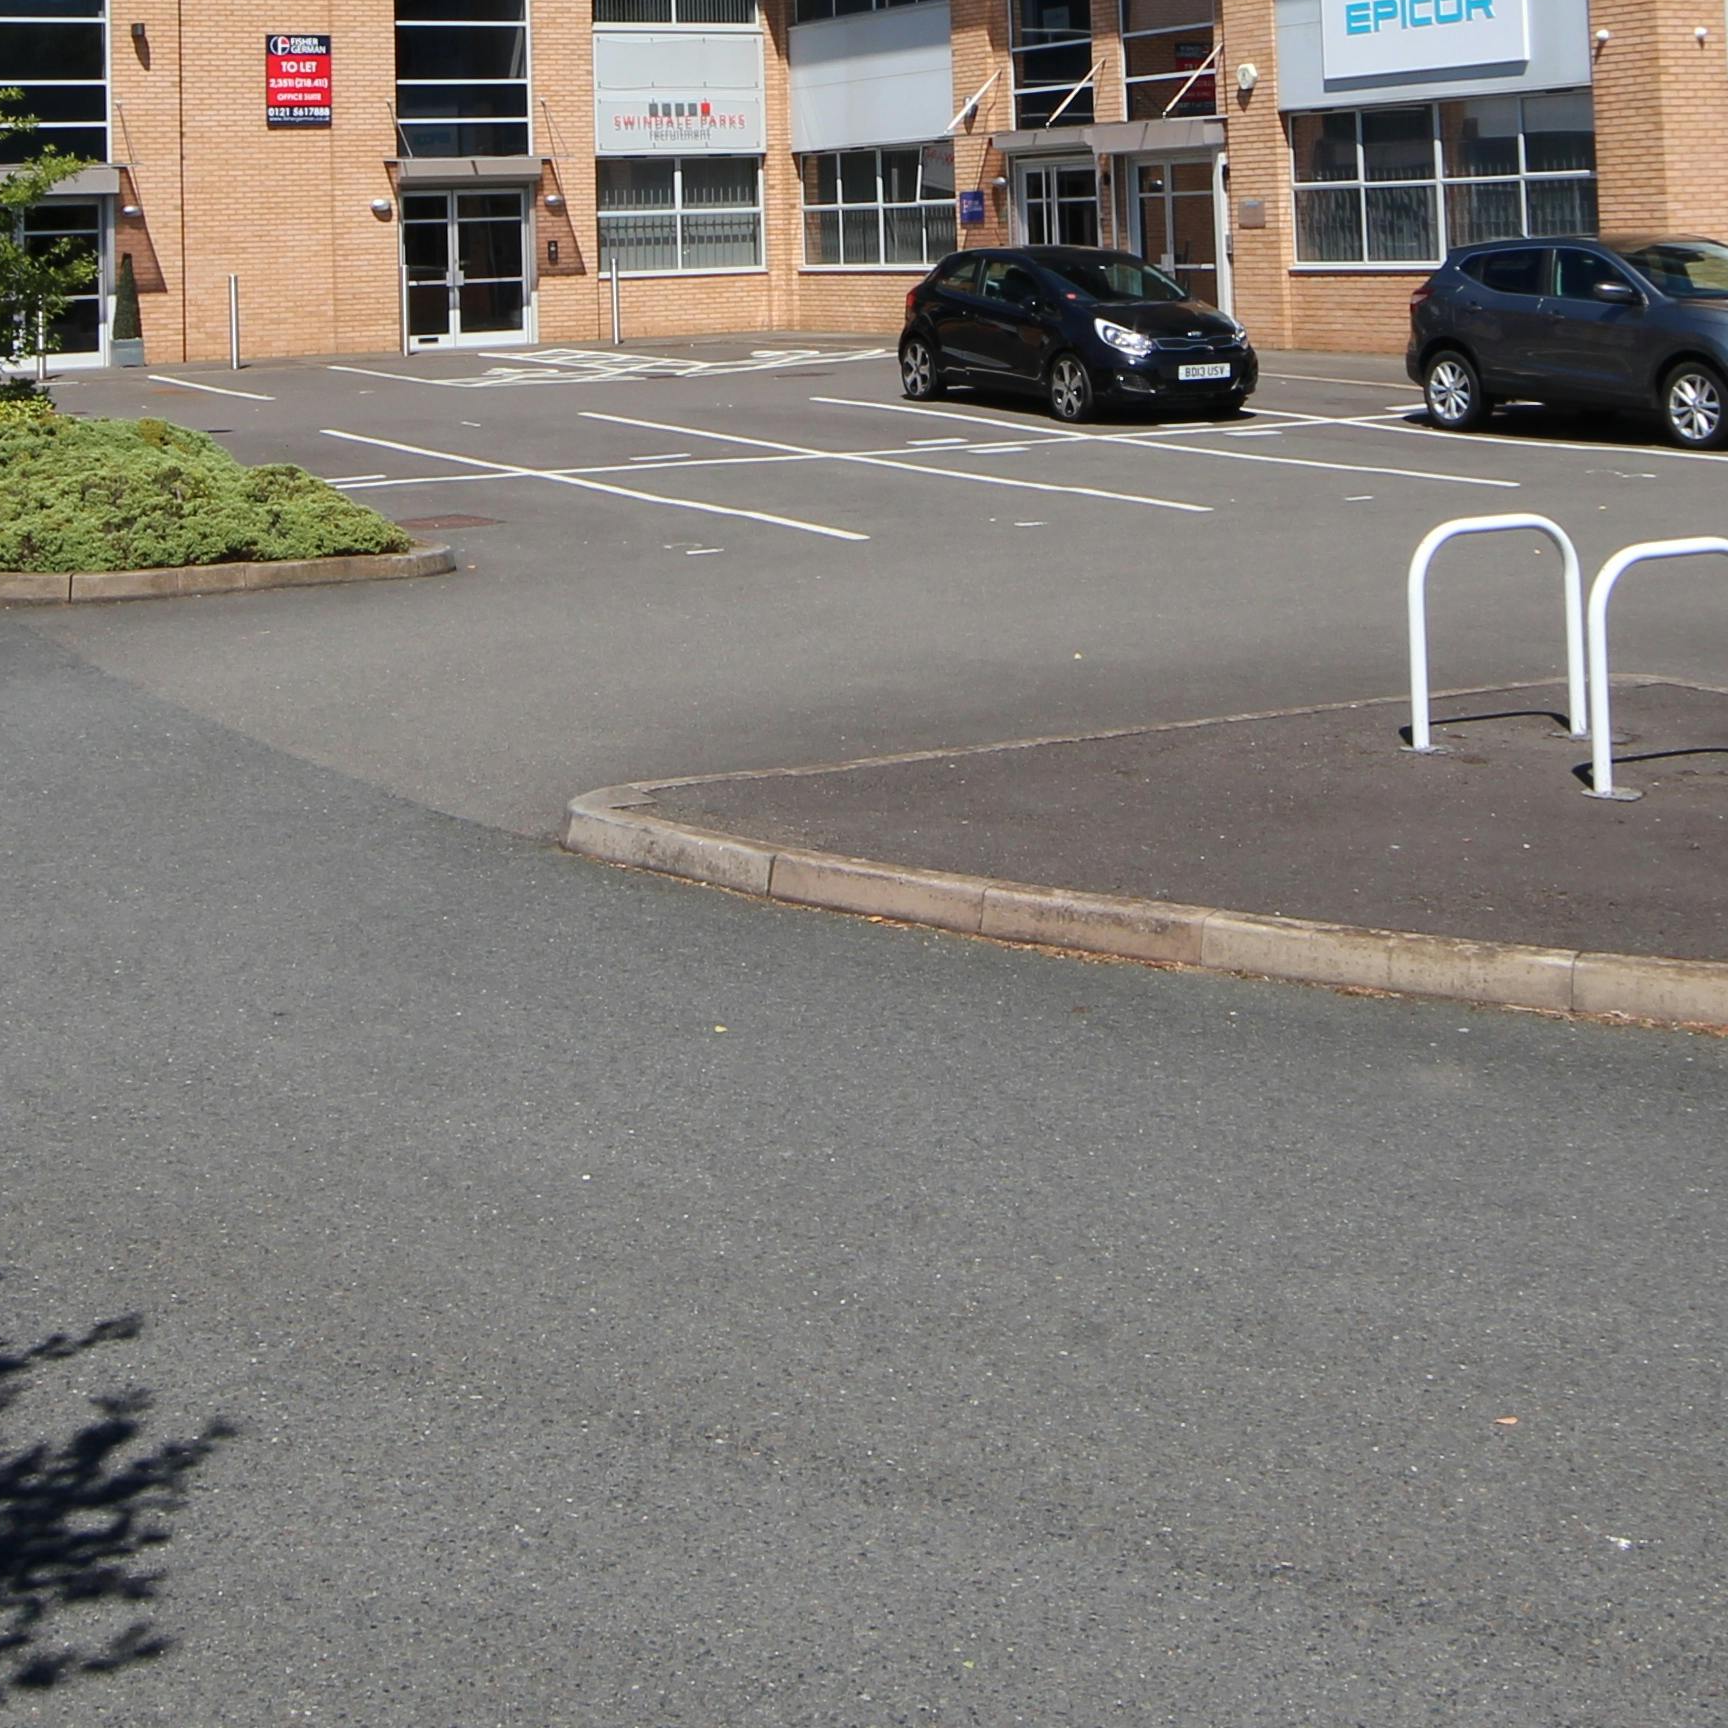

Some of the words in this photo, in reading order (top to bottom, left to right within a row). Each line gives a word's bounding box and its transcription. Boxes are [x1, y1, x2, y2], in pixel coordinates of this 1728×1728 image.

[290, 37, 318, 46] FISHER
[290, 45, 326, 54] GERMAN
[280, 61, 298, 73] TO
[299, 61, 317, 73] LET
[276, 92, 303, 101] OFFICE
[268, 107, 290, 116] 0121
[614, 114, 692, 131] SWINDALE
[700, 114, 745, 130] PARKS
